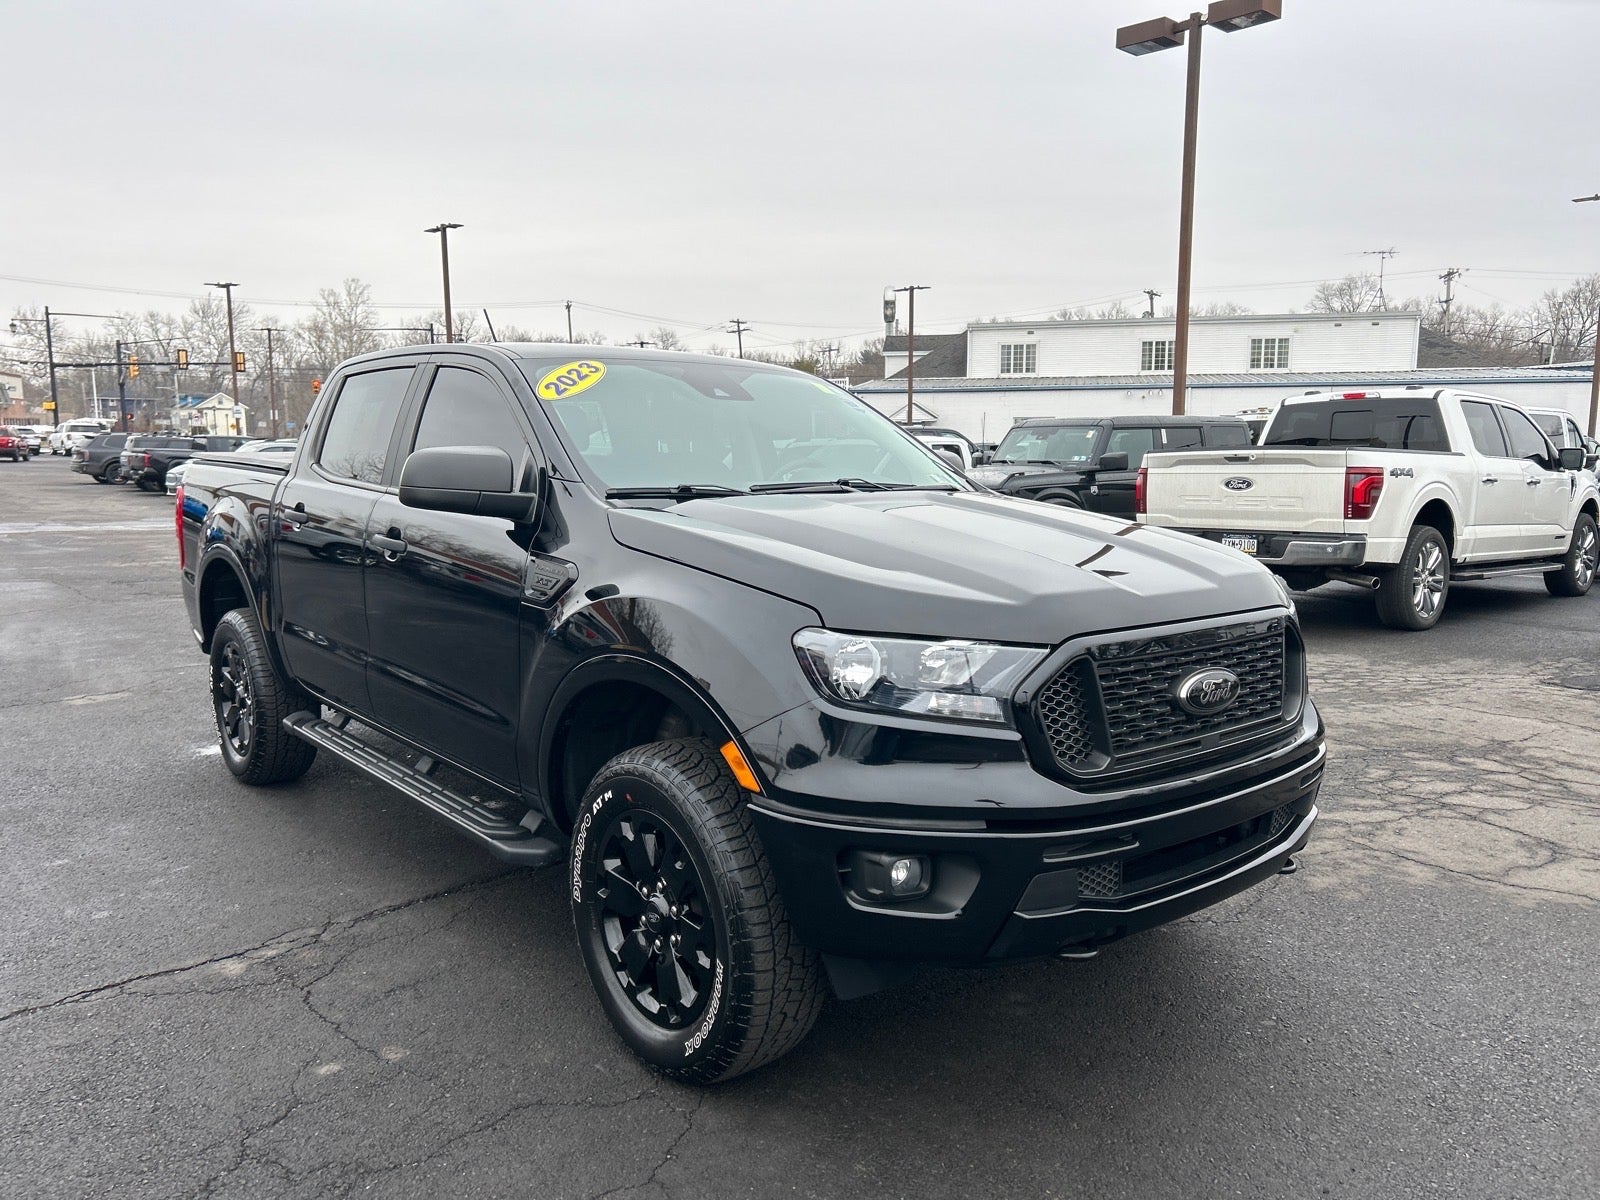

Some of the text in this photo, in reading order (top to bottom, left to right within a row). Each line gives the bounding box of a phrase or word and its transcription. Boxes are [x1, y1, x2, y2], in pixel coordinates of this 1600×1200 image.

[544, 362, 600, 396] 2023
[1389, 467, 1414, 479] 4X4
[1228, 480, 1248, 489] Ford
[535, 576, 553, 587] XLT
[1200, 678, 1232, 705] Ford
